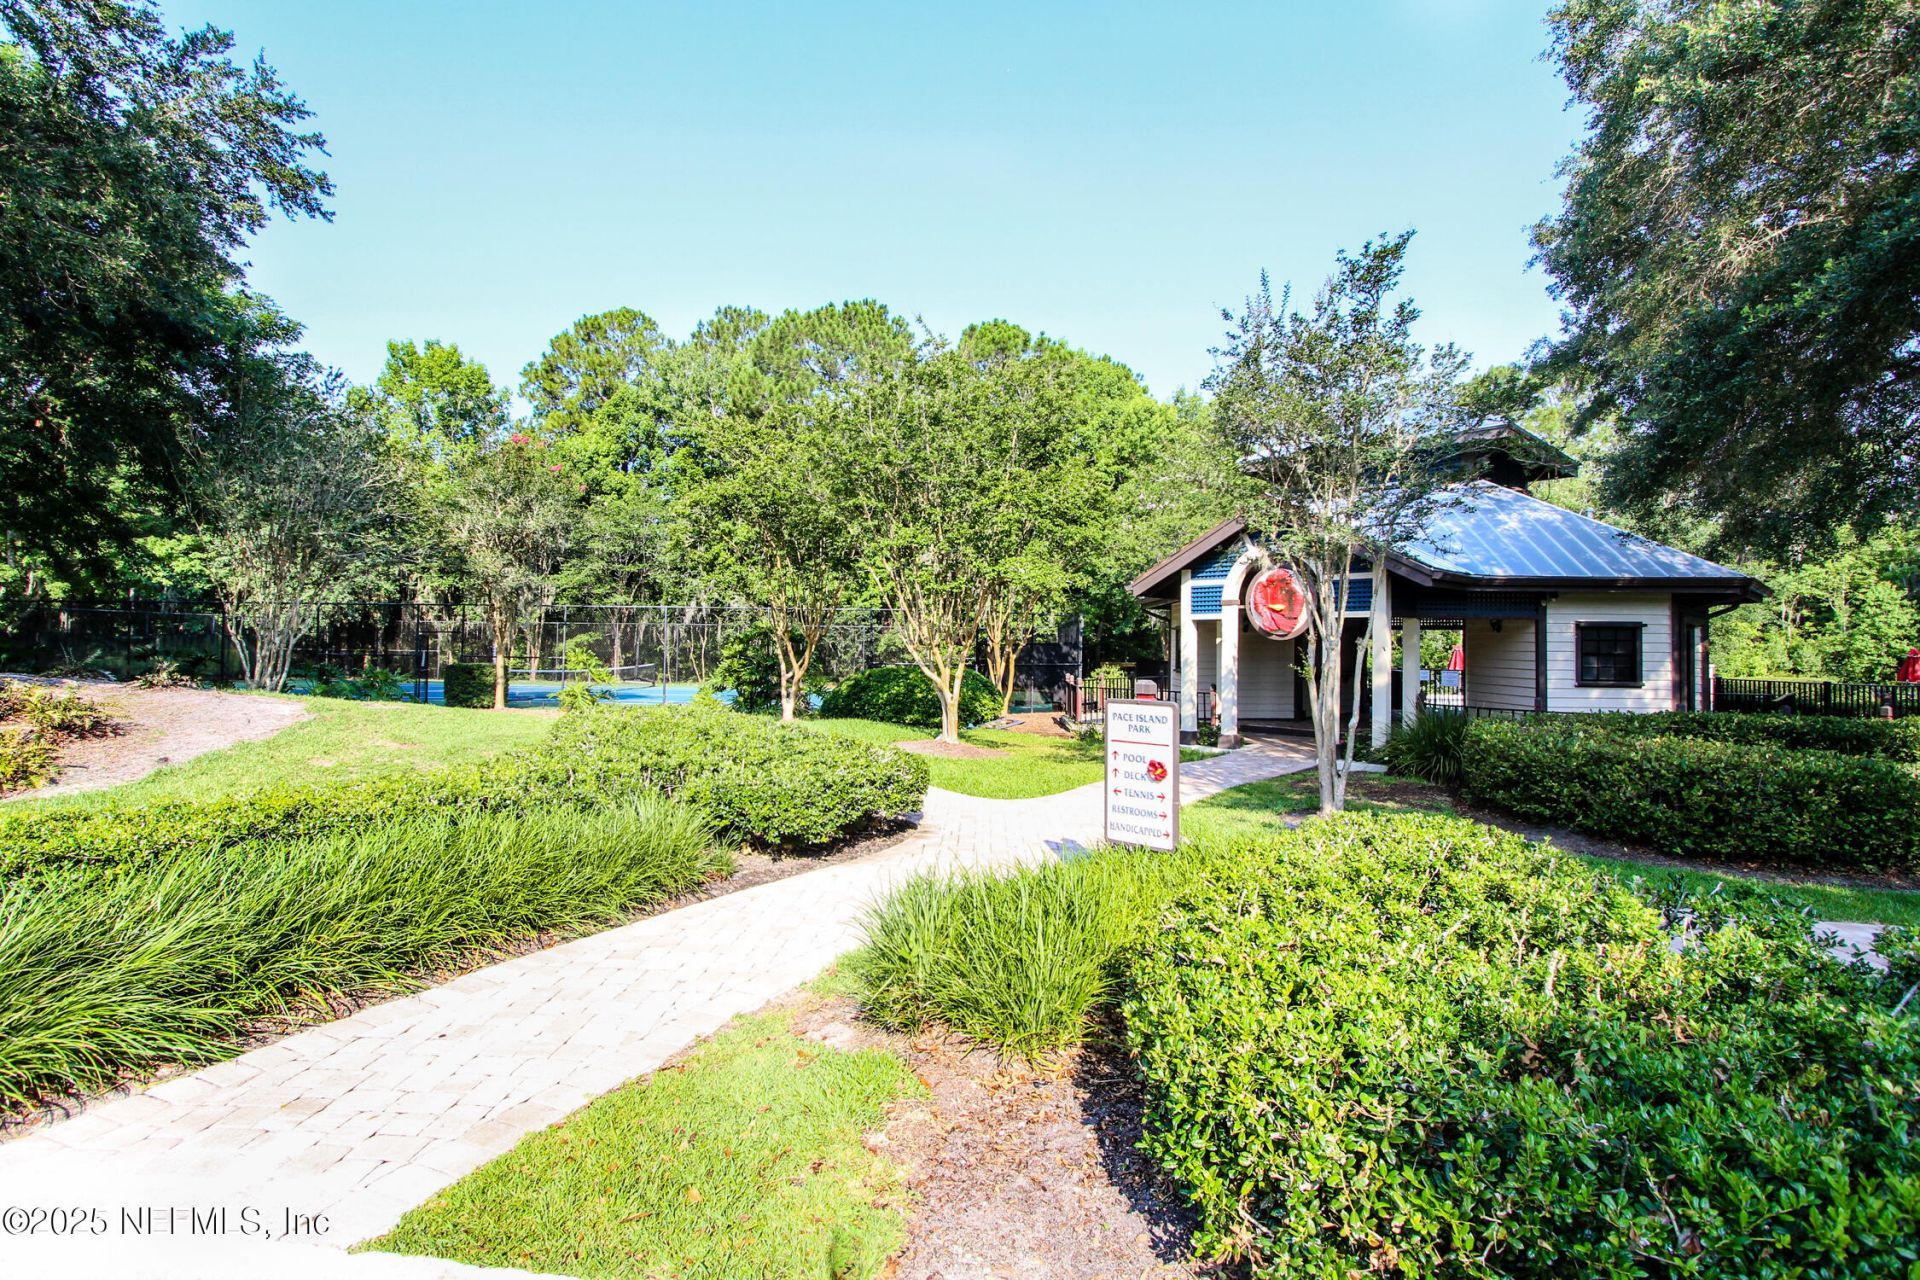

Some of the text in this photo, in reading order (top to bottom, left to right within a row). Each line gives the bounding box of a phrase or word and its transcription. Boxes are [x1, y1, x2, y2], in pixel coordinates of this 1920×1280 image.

[1112, 712, 1168, 724] PACE ISLAND
[1128, 724, 1151, 734] PARK
[1123, 753, 1147, 764] POOL
[1124, 771, 1147, 781] DECK
[1124, 788, 1155, 800] TENNIS
[1112, 804, 1158, 819] RESTROOMS
[1110, 821, 1163, 838] HANDICAPPED
